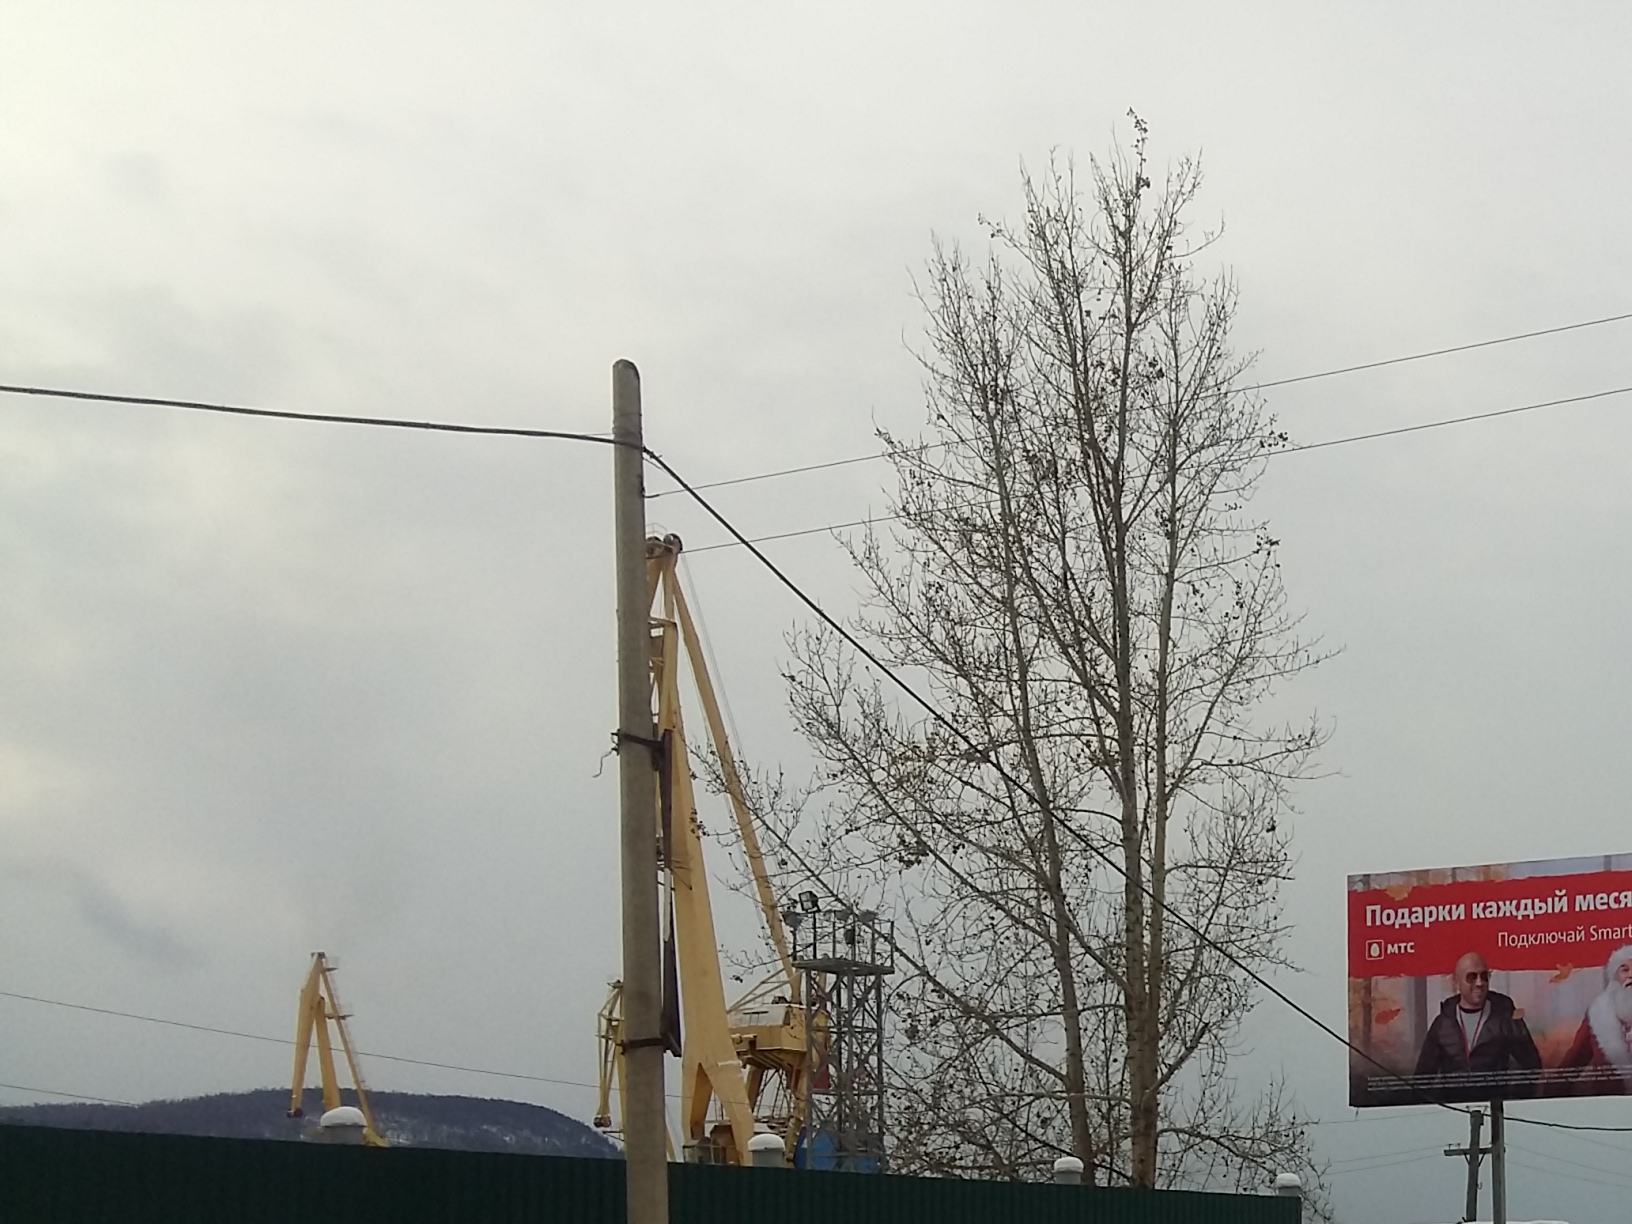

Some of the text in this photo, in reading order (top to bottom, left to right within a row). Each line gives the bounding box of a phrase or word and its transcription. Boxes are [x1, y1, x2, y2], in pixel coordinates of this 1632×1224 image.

[1365, 903, 1466, 930] Подарки
[1472, 889, 1568, 920] каждый
[1497, 926, 1585, 949] Подключай
